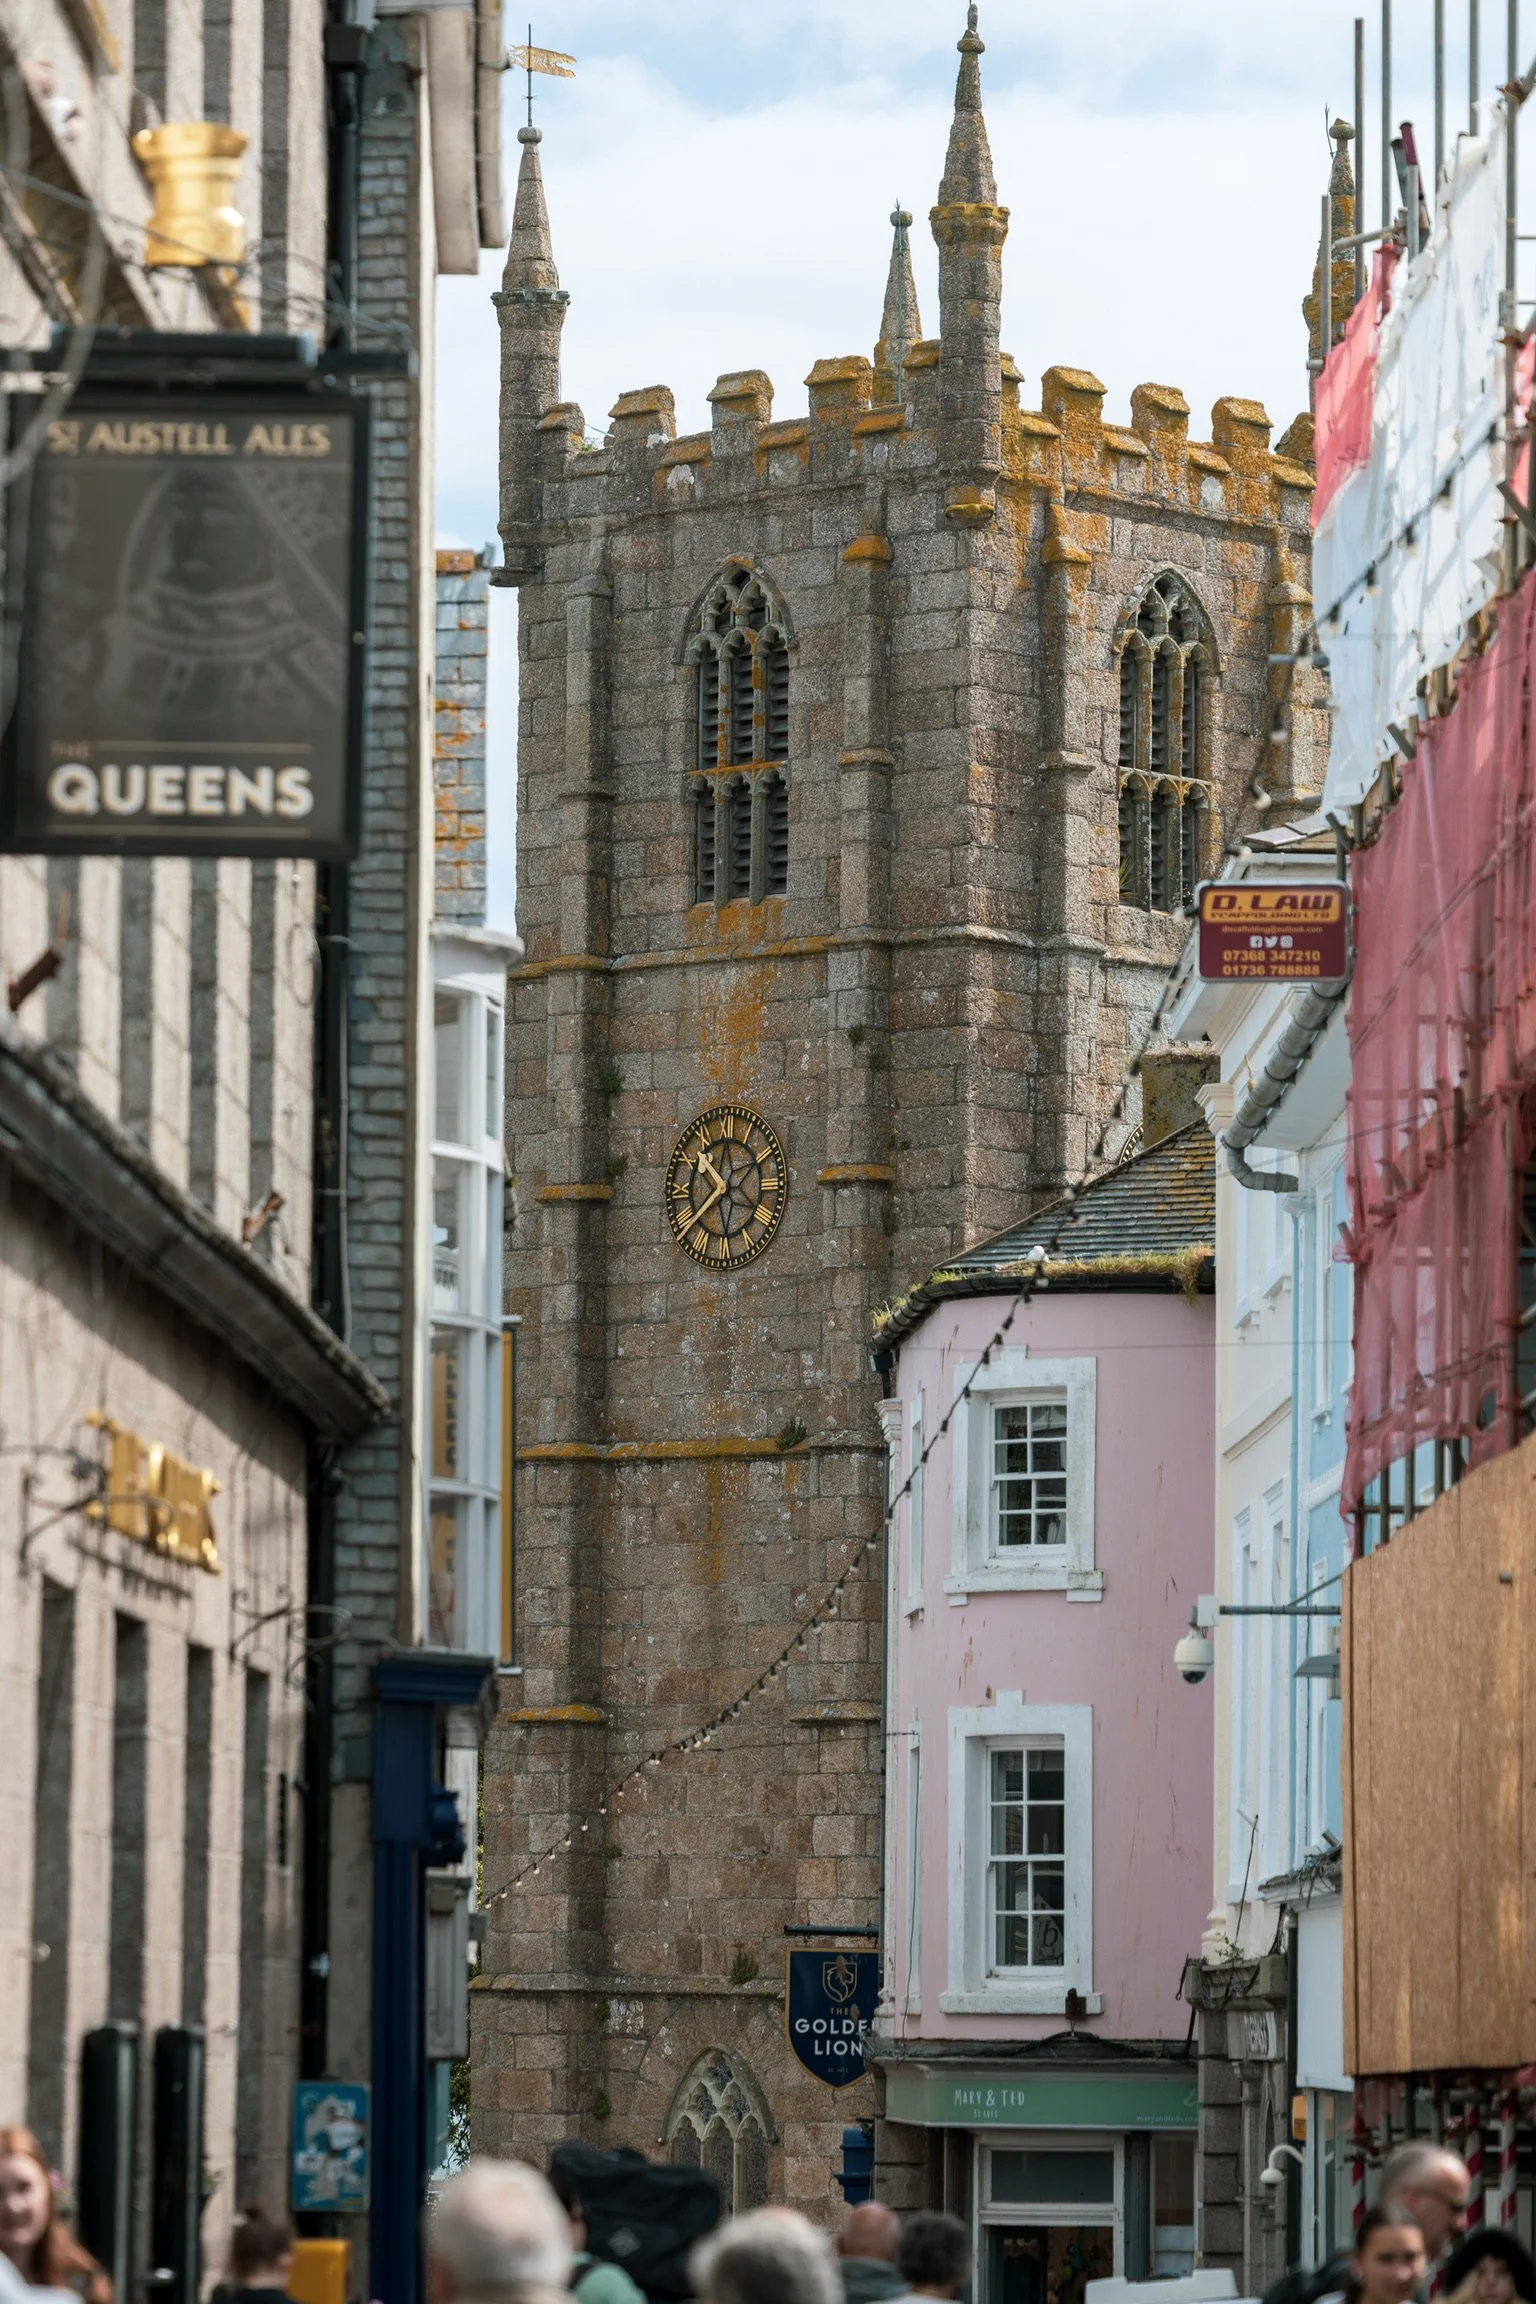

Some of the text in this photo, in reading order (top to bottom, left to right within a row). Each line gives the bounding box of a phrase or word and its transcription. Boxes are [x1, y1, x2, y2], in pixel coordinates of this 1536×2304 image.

[86, 421, 234, 456] AUSTELL
[243, 423, 332, 457] ALES
[47, 762, 315, 819] QUEENS
[1212, 894, 1334, 911] D. LAW
[1270, 950, 1321, 962] 347210
[1222, 965, 1266, 976] 01736
[830, 2007, 848, 2015] THE
[795, 2018, 875, 2035] GOLDE
[814, 2039, 863, 2056] LION
[986, 2089, 996, 2107] &
